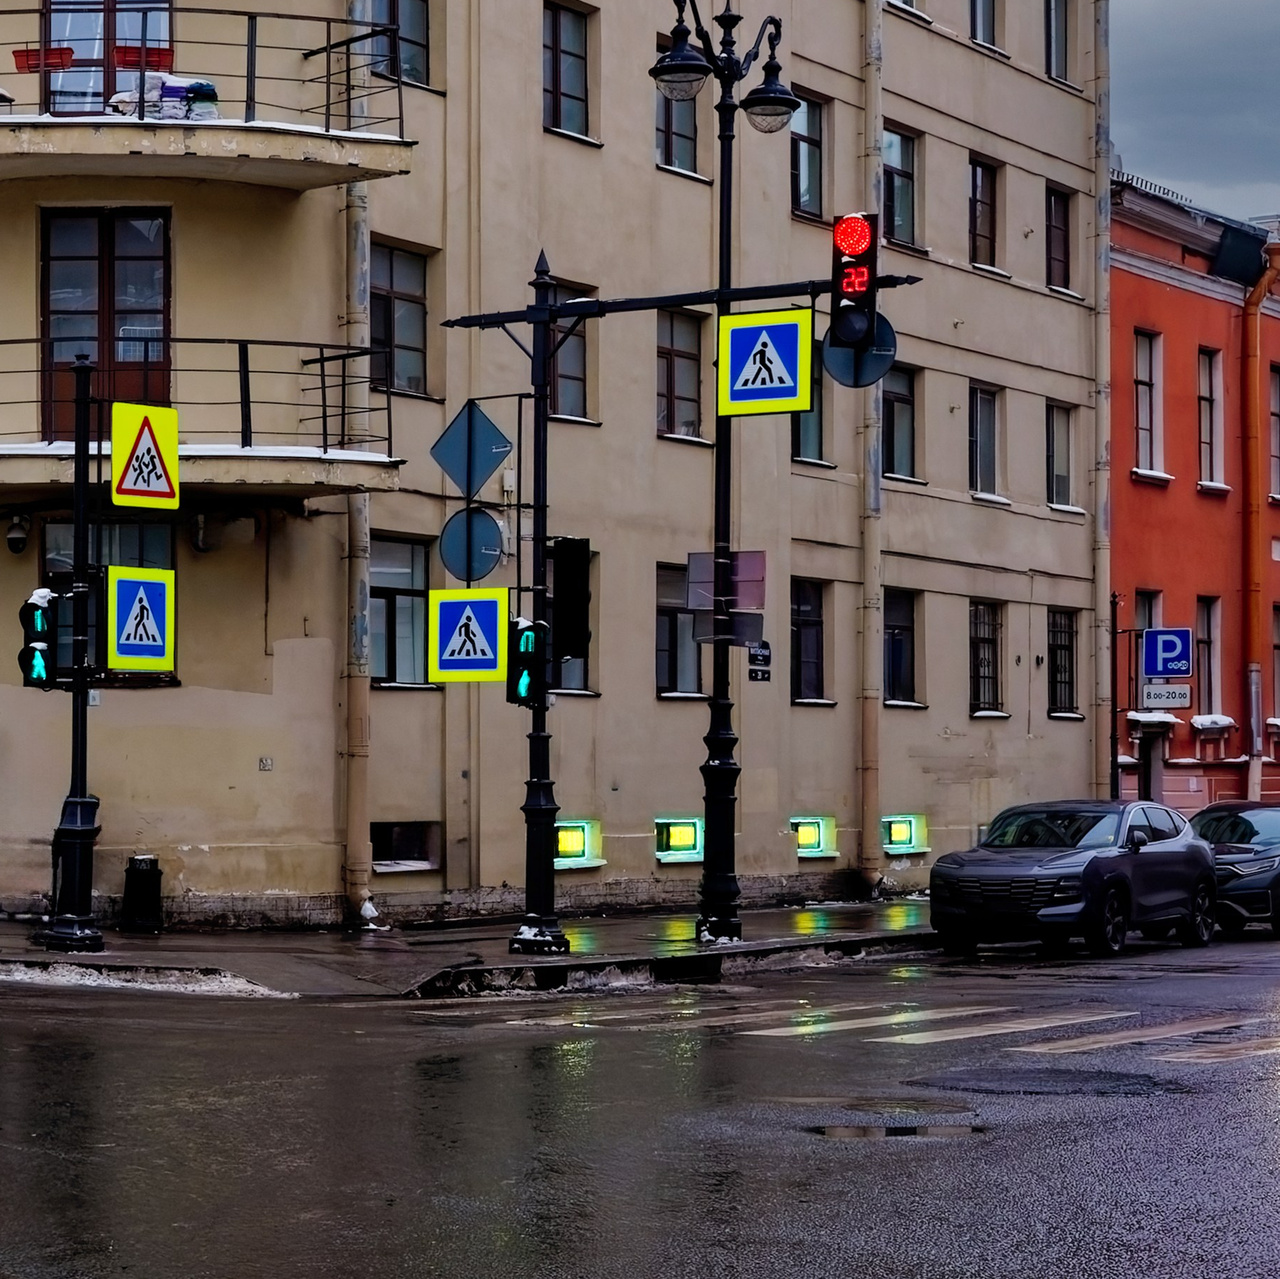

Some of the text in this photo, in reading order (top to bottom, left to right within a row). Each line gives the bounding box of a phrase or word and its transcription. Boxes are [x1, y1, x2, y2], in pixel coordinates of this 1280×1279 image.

[842, 266, 869, 292] 22
[1157, 635, 1182, 671] P
[1146, 691, 1188, 700] 8.00-20.00
